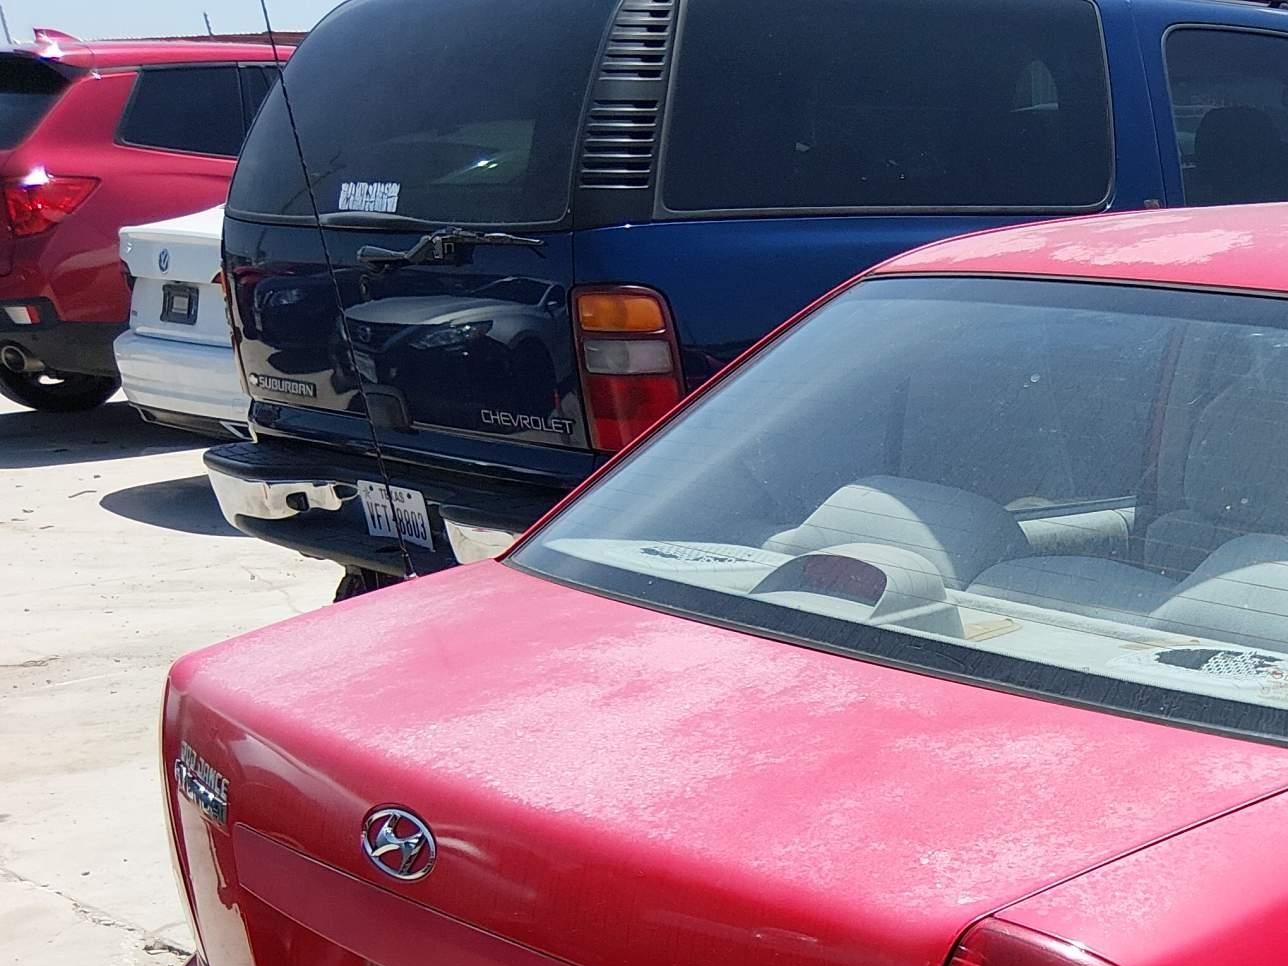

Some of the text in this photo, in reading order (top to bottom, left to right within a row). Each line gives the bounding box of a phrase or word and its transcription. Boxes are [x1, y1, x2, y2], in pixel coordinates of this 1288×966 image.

[258, 374, 314, 397] SUBURBAN
[481, 409, 575, 435] CHEVROLET
[379, 488, 405, 504] TEXAS
[367, 502, 427, 541] VFT 8803
